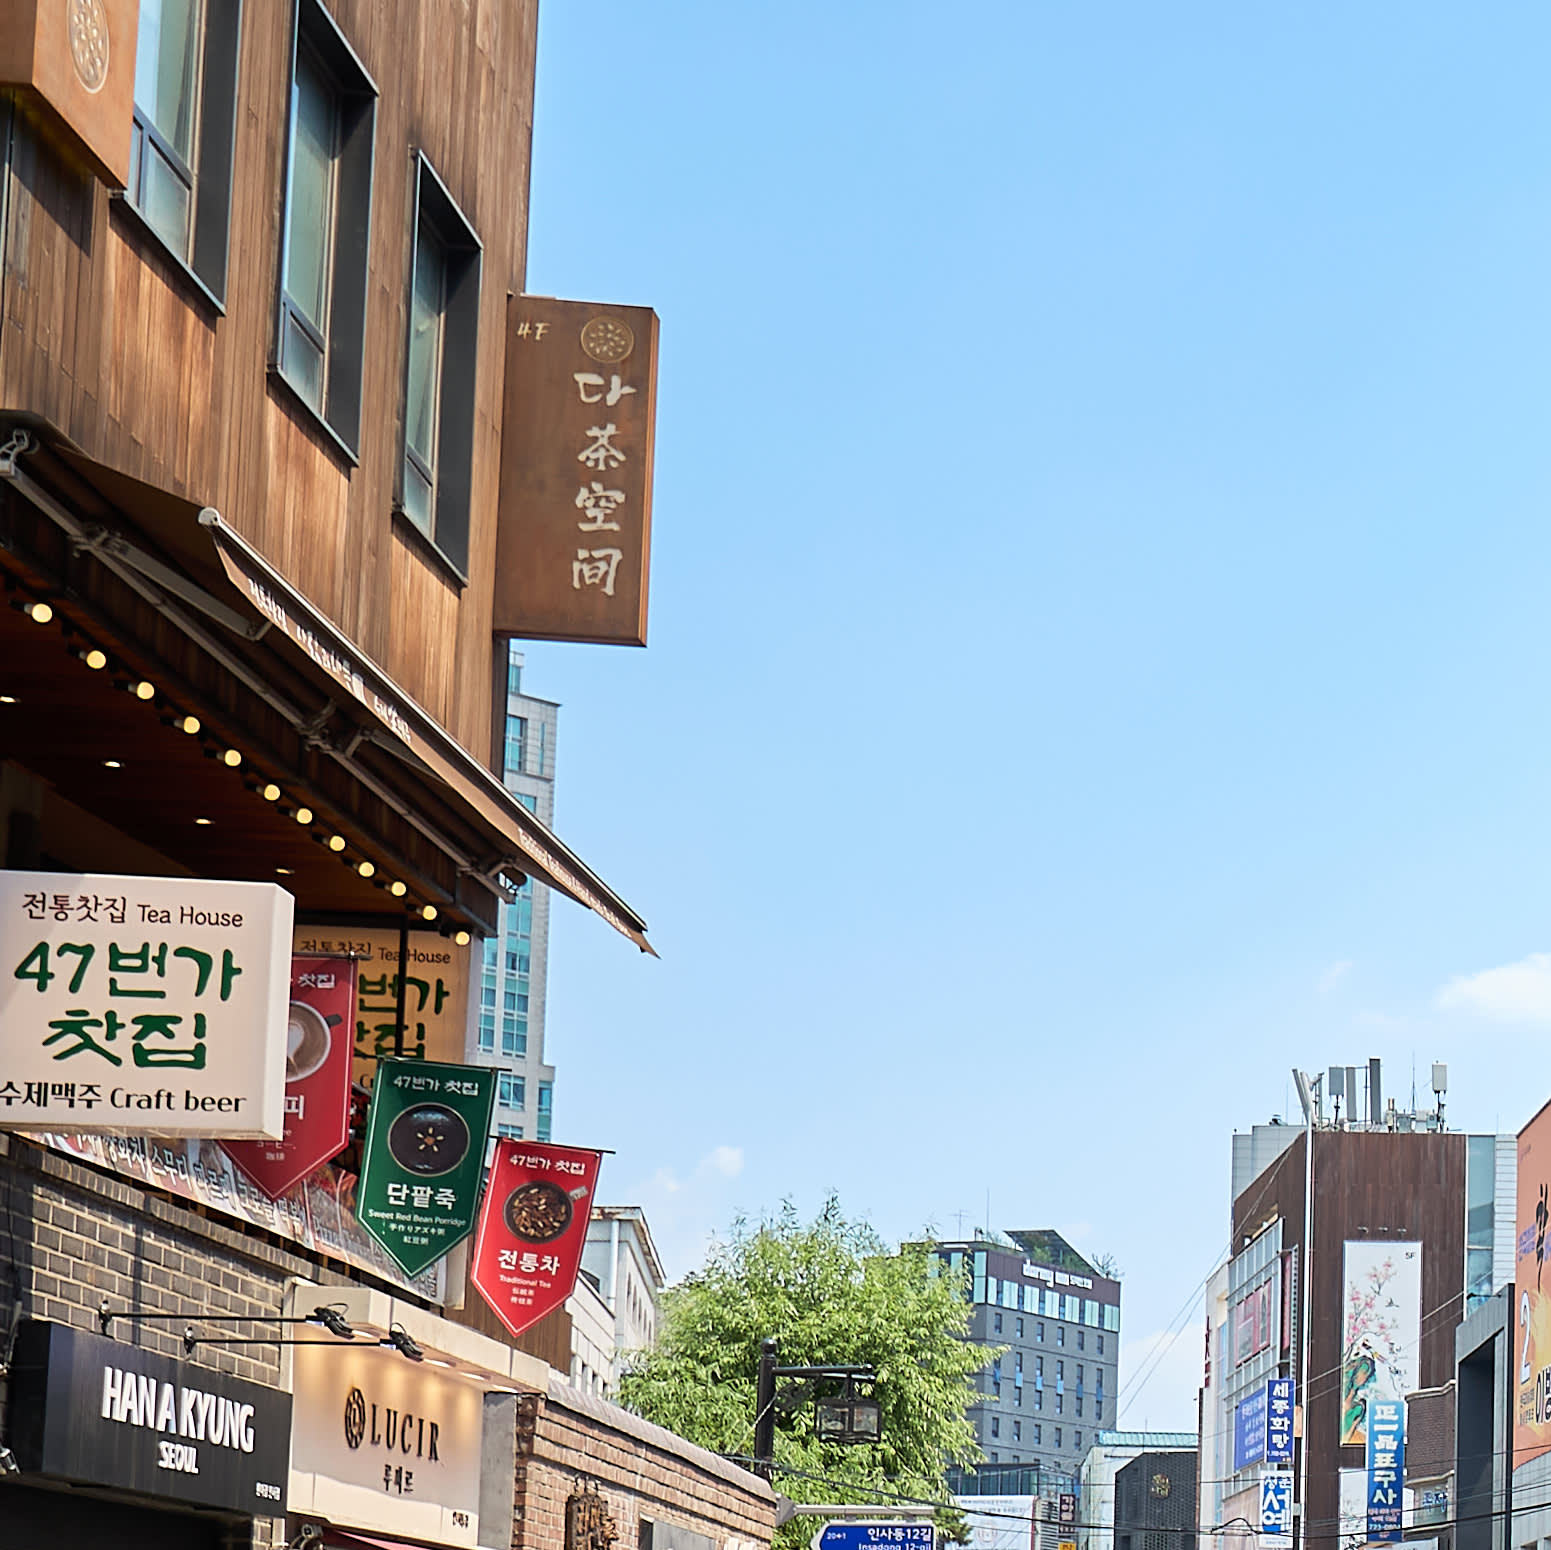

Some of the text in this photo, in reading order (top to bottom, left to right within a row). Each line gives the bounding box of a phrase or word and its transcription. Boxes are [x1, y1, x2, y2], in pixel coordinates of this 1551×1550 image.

[517, 321, 551, 342] 4F
[22, 892, 243, 928] 전통찻집 Tea House
[379, 947, 400, 961] Tea
[408, 946, 451, 964] House
[14, 941, 243, 1001] 47번가
[358, 973, 449, 1015] 번가
[42, 1009, 207, 1070] 찻집
[0, 1081, 247, 1113] 수제맥주 Craft beer
[393, 1075, 440, 1091] 47번가
[284, 1096, 304, 1120] 피
[509, 1155, 551, 1170] 47번가
[387, 1182, 456, 1210] 단팥죽
[396, 1212, 412, 1222] Red
[497, 1249, 560, 1276] 전통차
[101, 1366, 255, 1453] HAN A KYUNG
[371, 1403, 439, 1462] LUCIR
[158, 1440, 199, 1474] SEOUL
[867, 1528, 932, 1542] 인사동12길
